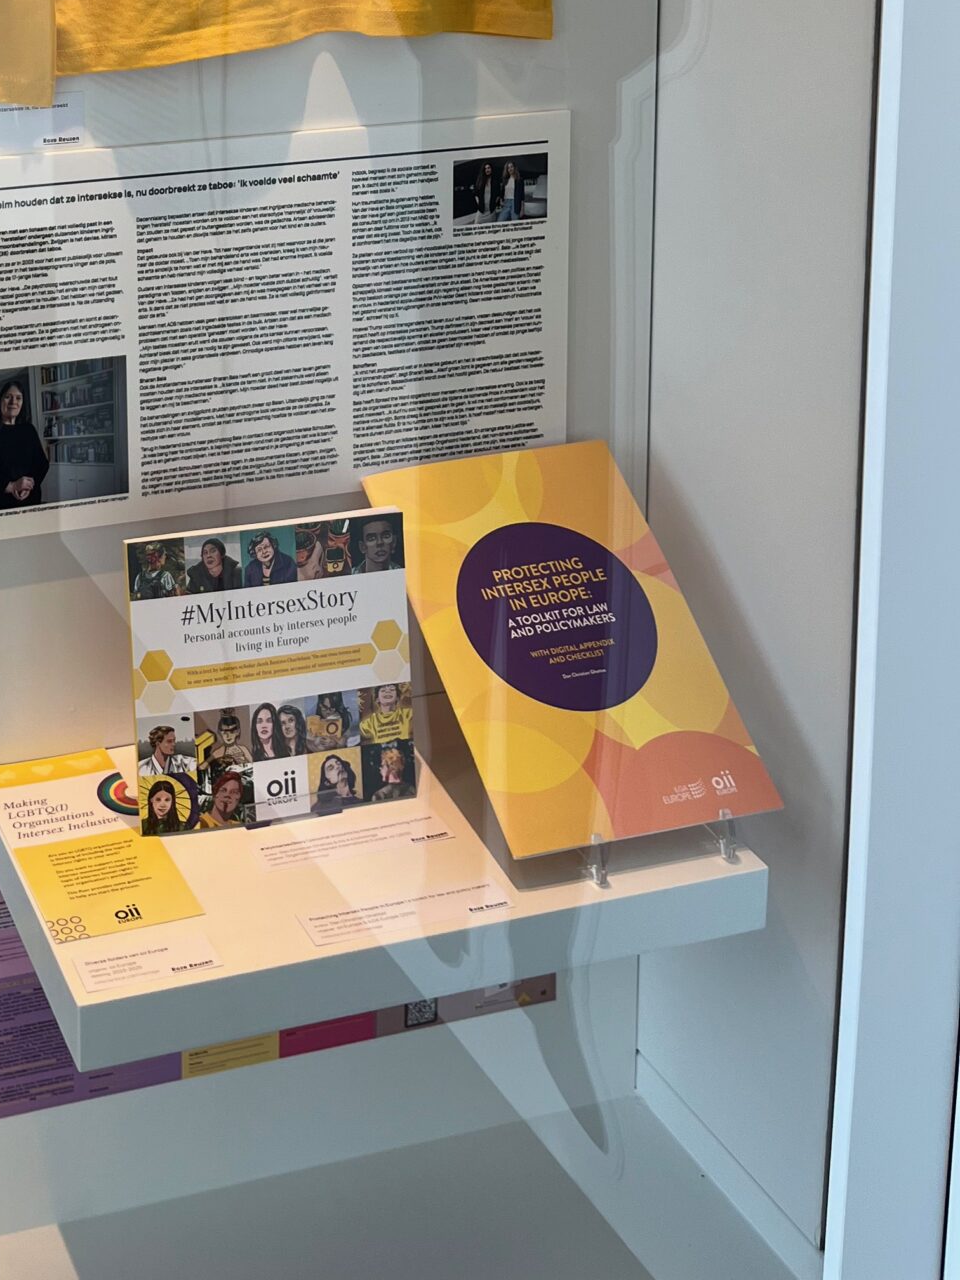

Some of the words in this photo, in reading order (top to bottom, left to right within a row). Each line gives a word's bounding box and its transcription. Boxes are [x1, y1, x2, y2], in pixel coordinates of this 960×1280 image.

[14, 197, 49, 208] houden
[49, 195, 65, 205] dat
[65, 195, 77, 204] ze
[77, 191, 123, 203] intersekse
[135, 189, 148, 197] nu
[148, 183, 197, 196] doorbreekt
[197, 183, 208, 192] ze
[248, 176, 277, 187] voelde
[277, 174, 296, 185] veel
[492, 557, 583, 583] PROTECTING
[480, 577, 552, 601] INTERSEX
[551, 568, 608, 588] PEOPLE
[180, 589, 358, 629] #MyIntersexStory
[509, 596, 528, 611] IN
[528, 588, 593, 608] EUROPE:
[508, 617, 518, 628] A
[516, 609, 561, 626] TOOLKIT
[561, 606, 586, 618] FOR
[585, 602, 608, 615] LAW
[511, 626, 535, 639] AND
[535, 612, 616, 634] POLICYMAKERS
[183, 627, 225, 644] Personal
[227, 625, 271, 639] accounts
[273, 622, 284, 635] by
[287, 619, 325, 631] intersex
[326, 612, 358, 629] people
[235, 641, 263, 653] living
[264, 639, 275, 649] in
[276, 635, 310, 647] Europe
[529, 648, 551, 658] WITH
[549, 644, 579, 655] DIGITAL
[579, 638, 616, 650] APPENDIX
[549, 655, 566, 665] AND
[565, 648, 605, 662] CHECKLIST
[266, 770, 297, 797] oii
[711, 770, 736, 789] oii
[3, 798, 48, 811] Making
[8, 803, 69, 820] LGBTQ(I)
[12, 810, 95, 829] Organisations
[17, 826, 64, 840] Intersex
[68, 815, 122, 831] Inclusive
[114, 903, 141, 920] oii
